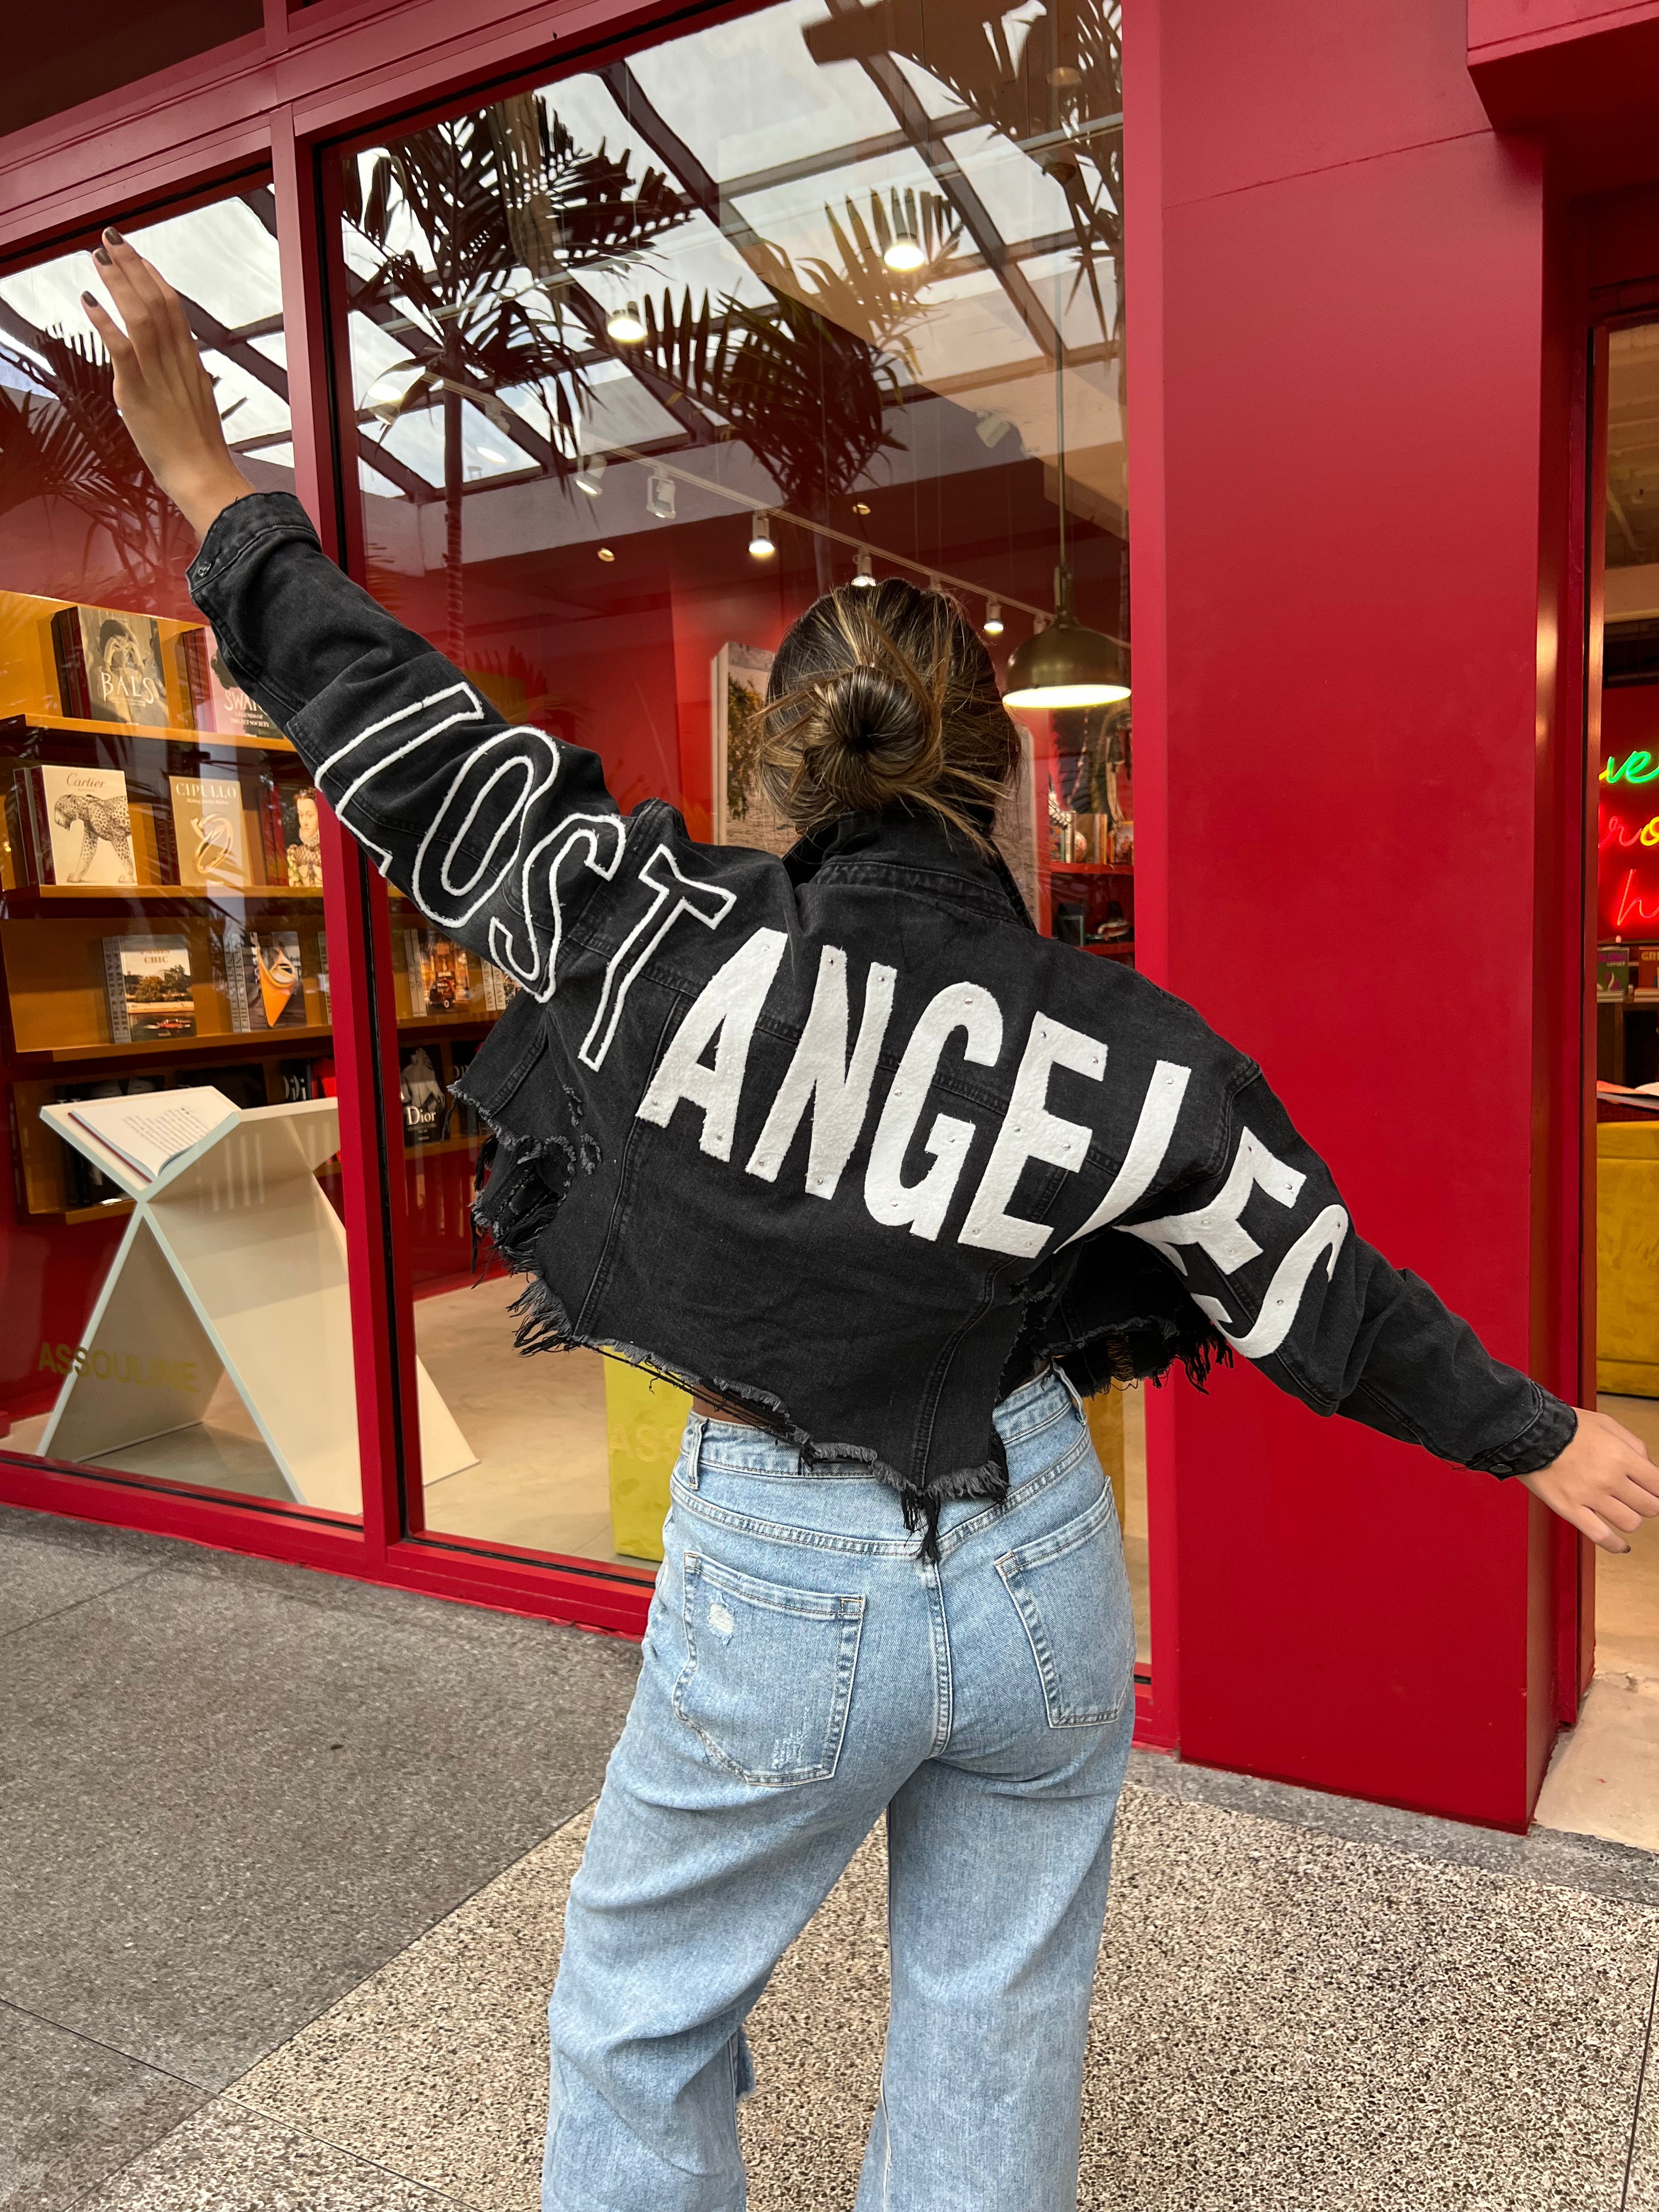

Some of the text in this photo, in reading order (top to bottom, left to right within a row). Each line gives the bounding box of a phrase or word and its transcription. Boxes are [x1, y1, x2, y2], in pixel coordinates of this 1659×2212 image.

[101, 672, 154, 704] BALS
[66, 772, 106, 788] Cartier
[176, 783, 236, 799] CIPULLO
[314, 682, 737, 1072] LOST
[406, 1105, 437, 1126] Dior
[38, 1342, 199, 1394] ASSOULINE
